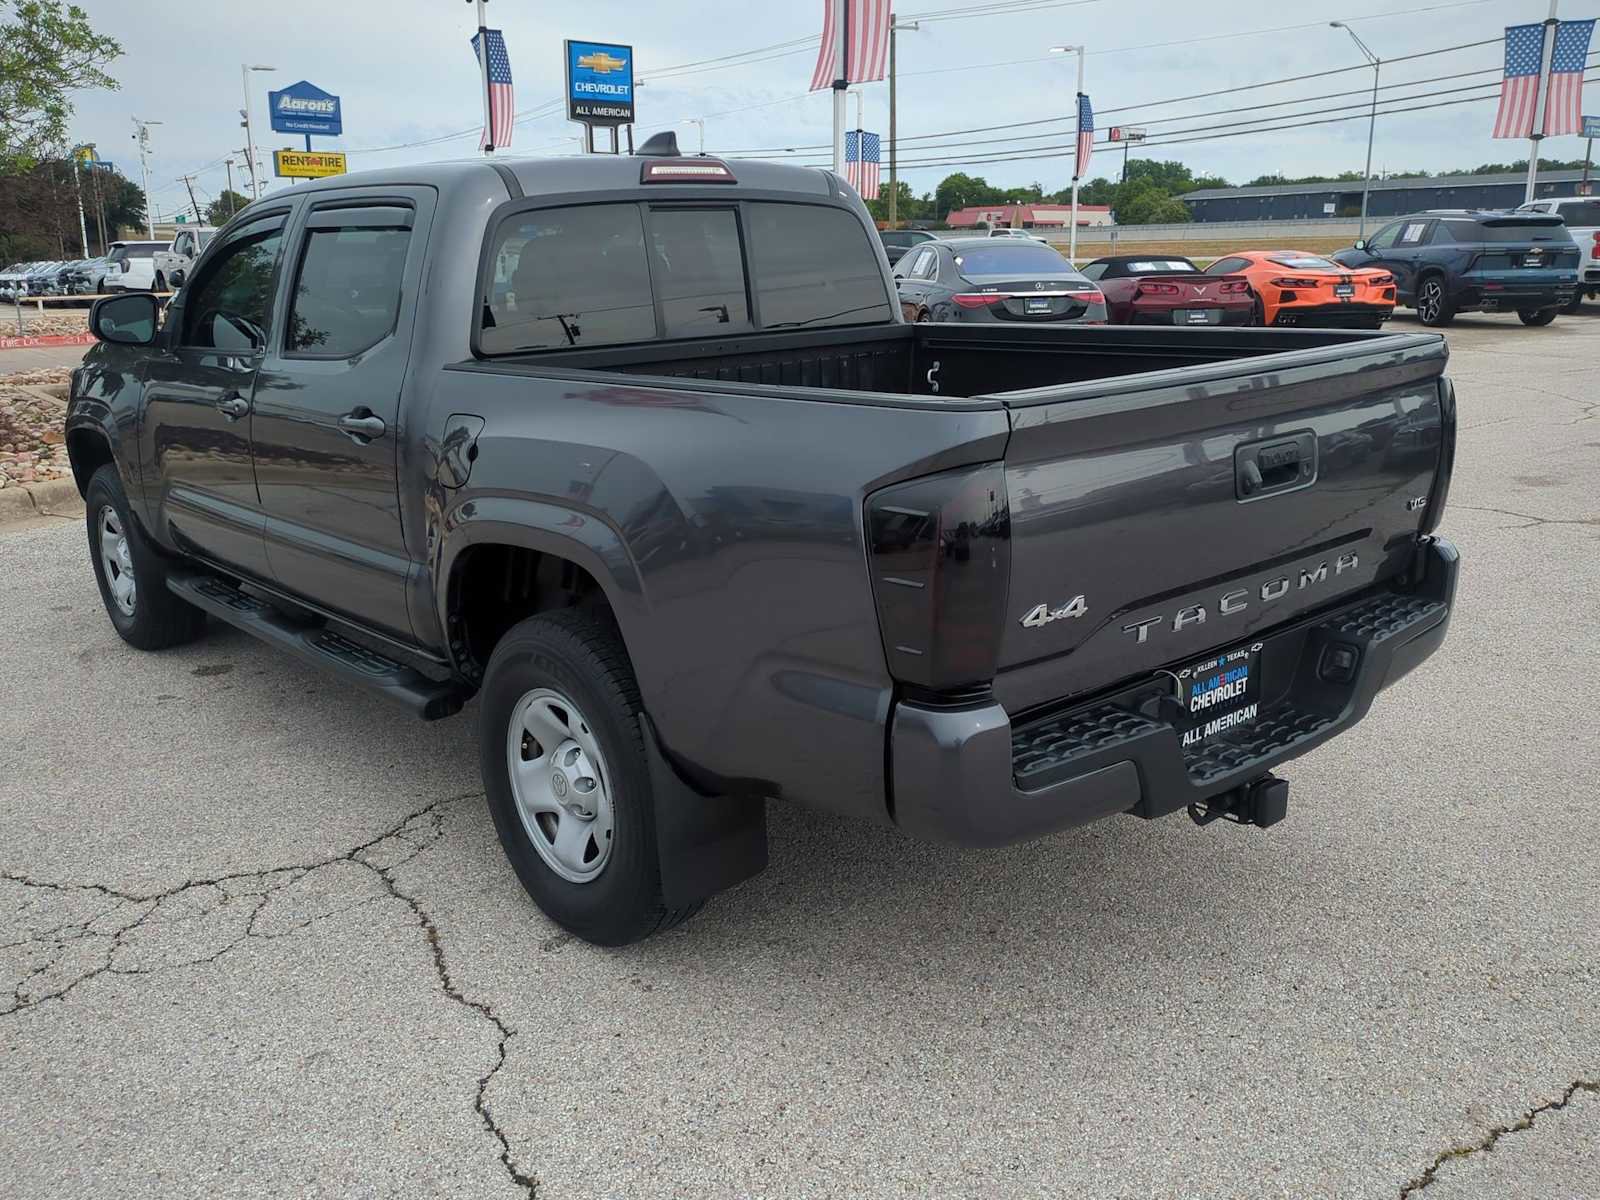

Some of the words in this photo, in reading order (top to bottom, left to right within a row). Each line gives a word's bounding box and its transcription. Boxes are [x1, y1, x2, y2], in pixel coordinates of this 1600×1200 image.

[278, 95, 336, 112] Aaron's
[575, 82, 629, 95] CHEVROLET
[575, 105, 591, 115] ALL
[592, 107, 631, 117] AMERICAN
[1019, 594, 1089, 628] 4x4
[1121, 552, 1359, 644] TACOMA
[1197, 659, 1218, 674] KILLEEN
[1227, 649, 1245, 662] TEXAS
[1190, 677, 1248, 713] CHEVROLET
[1191, 682, 1208, 697] ALL
[1208, 665, 1249, 690] AMERICAN
[1182, 729, 1203, 748] ALL
[1204, 703, 1258, 738] AMERICAN
